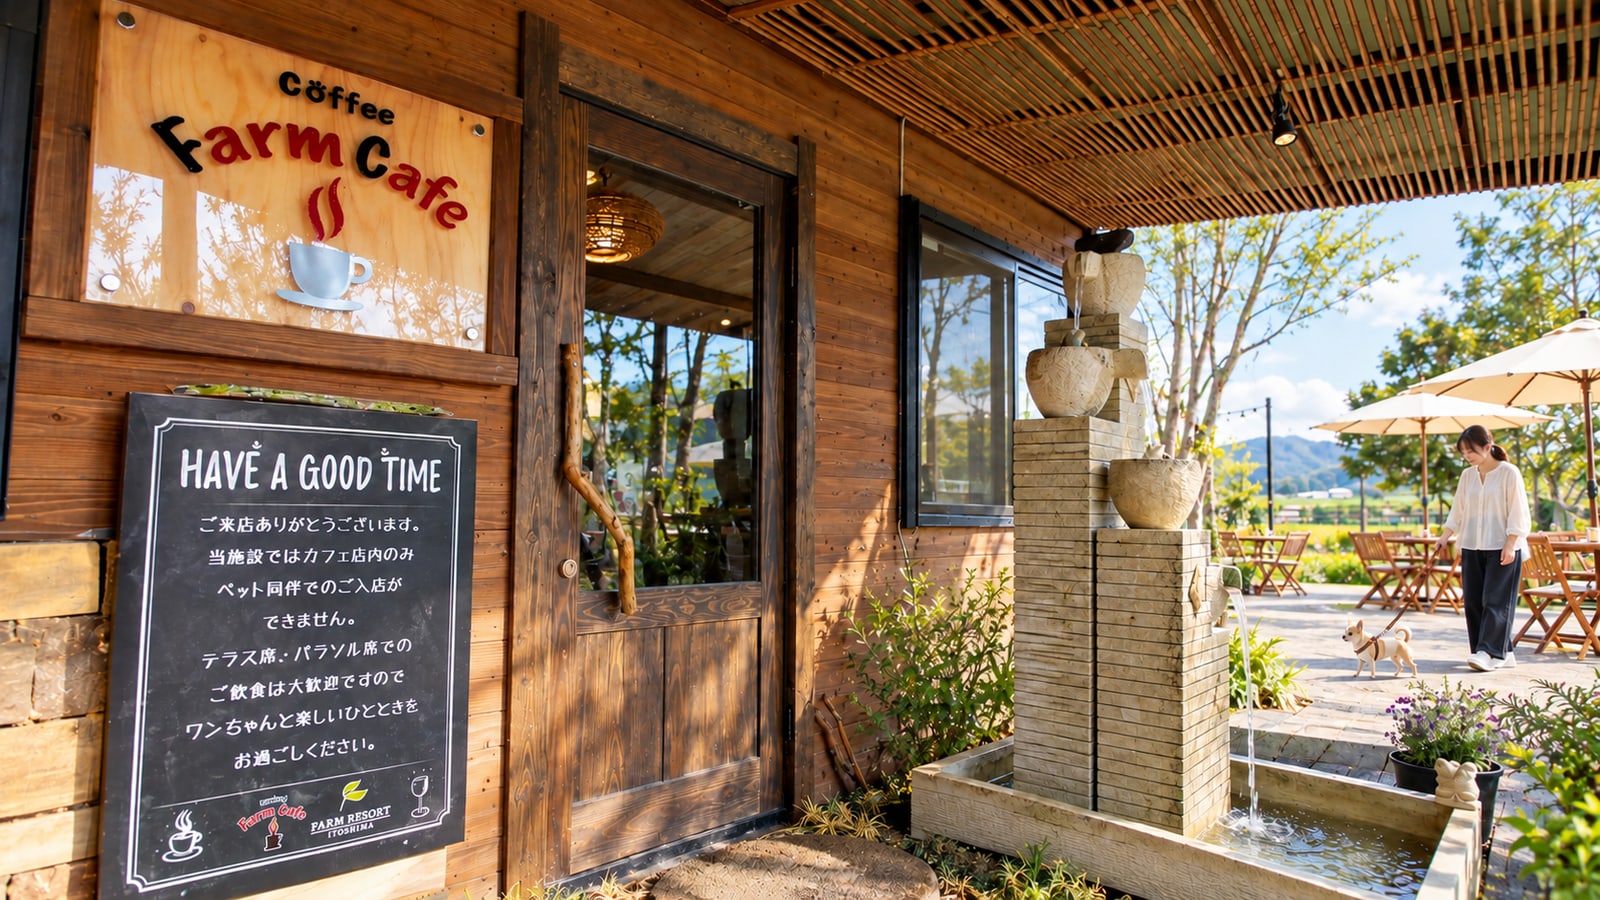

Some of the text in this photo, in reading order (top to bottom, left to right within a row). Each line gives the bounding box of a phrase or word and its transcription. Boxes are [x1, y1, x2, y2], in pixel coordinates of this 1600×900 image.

[151, 115, 469, 230] Farm Cafe
[180, 442, 442, 493] HAVE A GOOD TIME
[199, 514, 420, 534] ご来店ありがとうございます。
[207, 546, 416, 567] 当施設ではカフェ店内のみ
[216, 576, 404, 600] ペット同伴でのご入店が
[262, 610, 357, 631] できません。
[209, 668, 406, 704] ご飲食は大歓迎ですので
[185, 698, 418, 740] ワンちゃんと楽しいひとときを
[233, 741, 376, 771] お過ごしください。
[310, 805, 391, 832] FARM RESORT
[327, 823, 374, 838] ITOSHIMA
